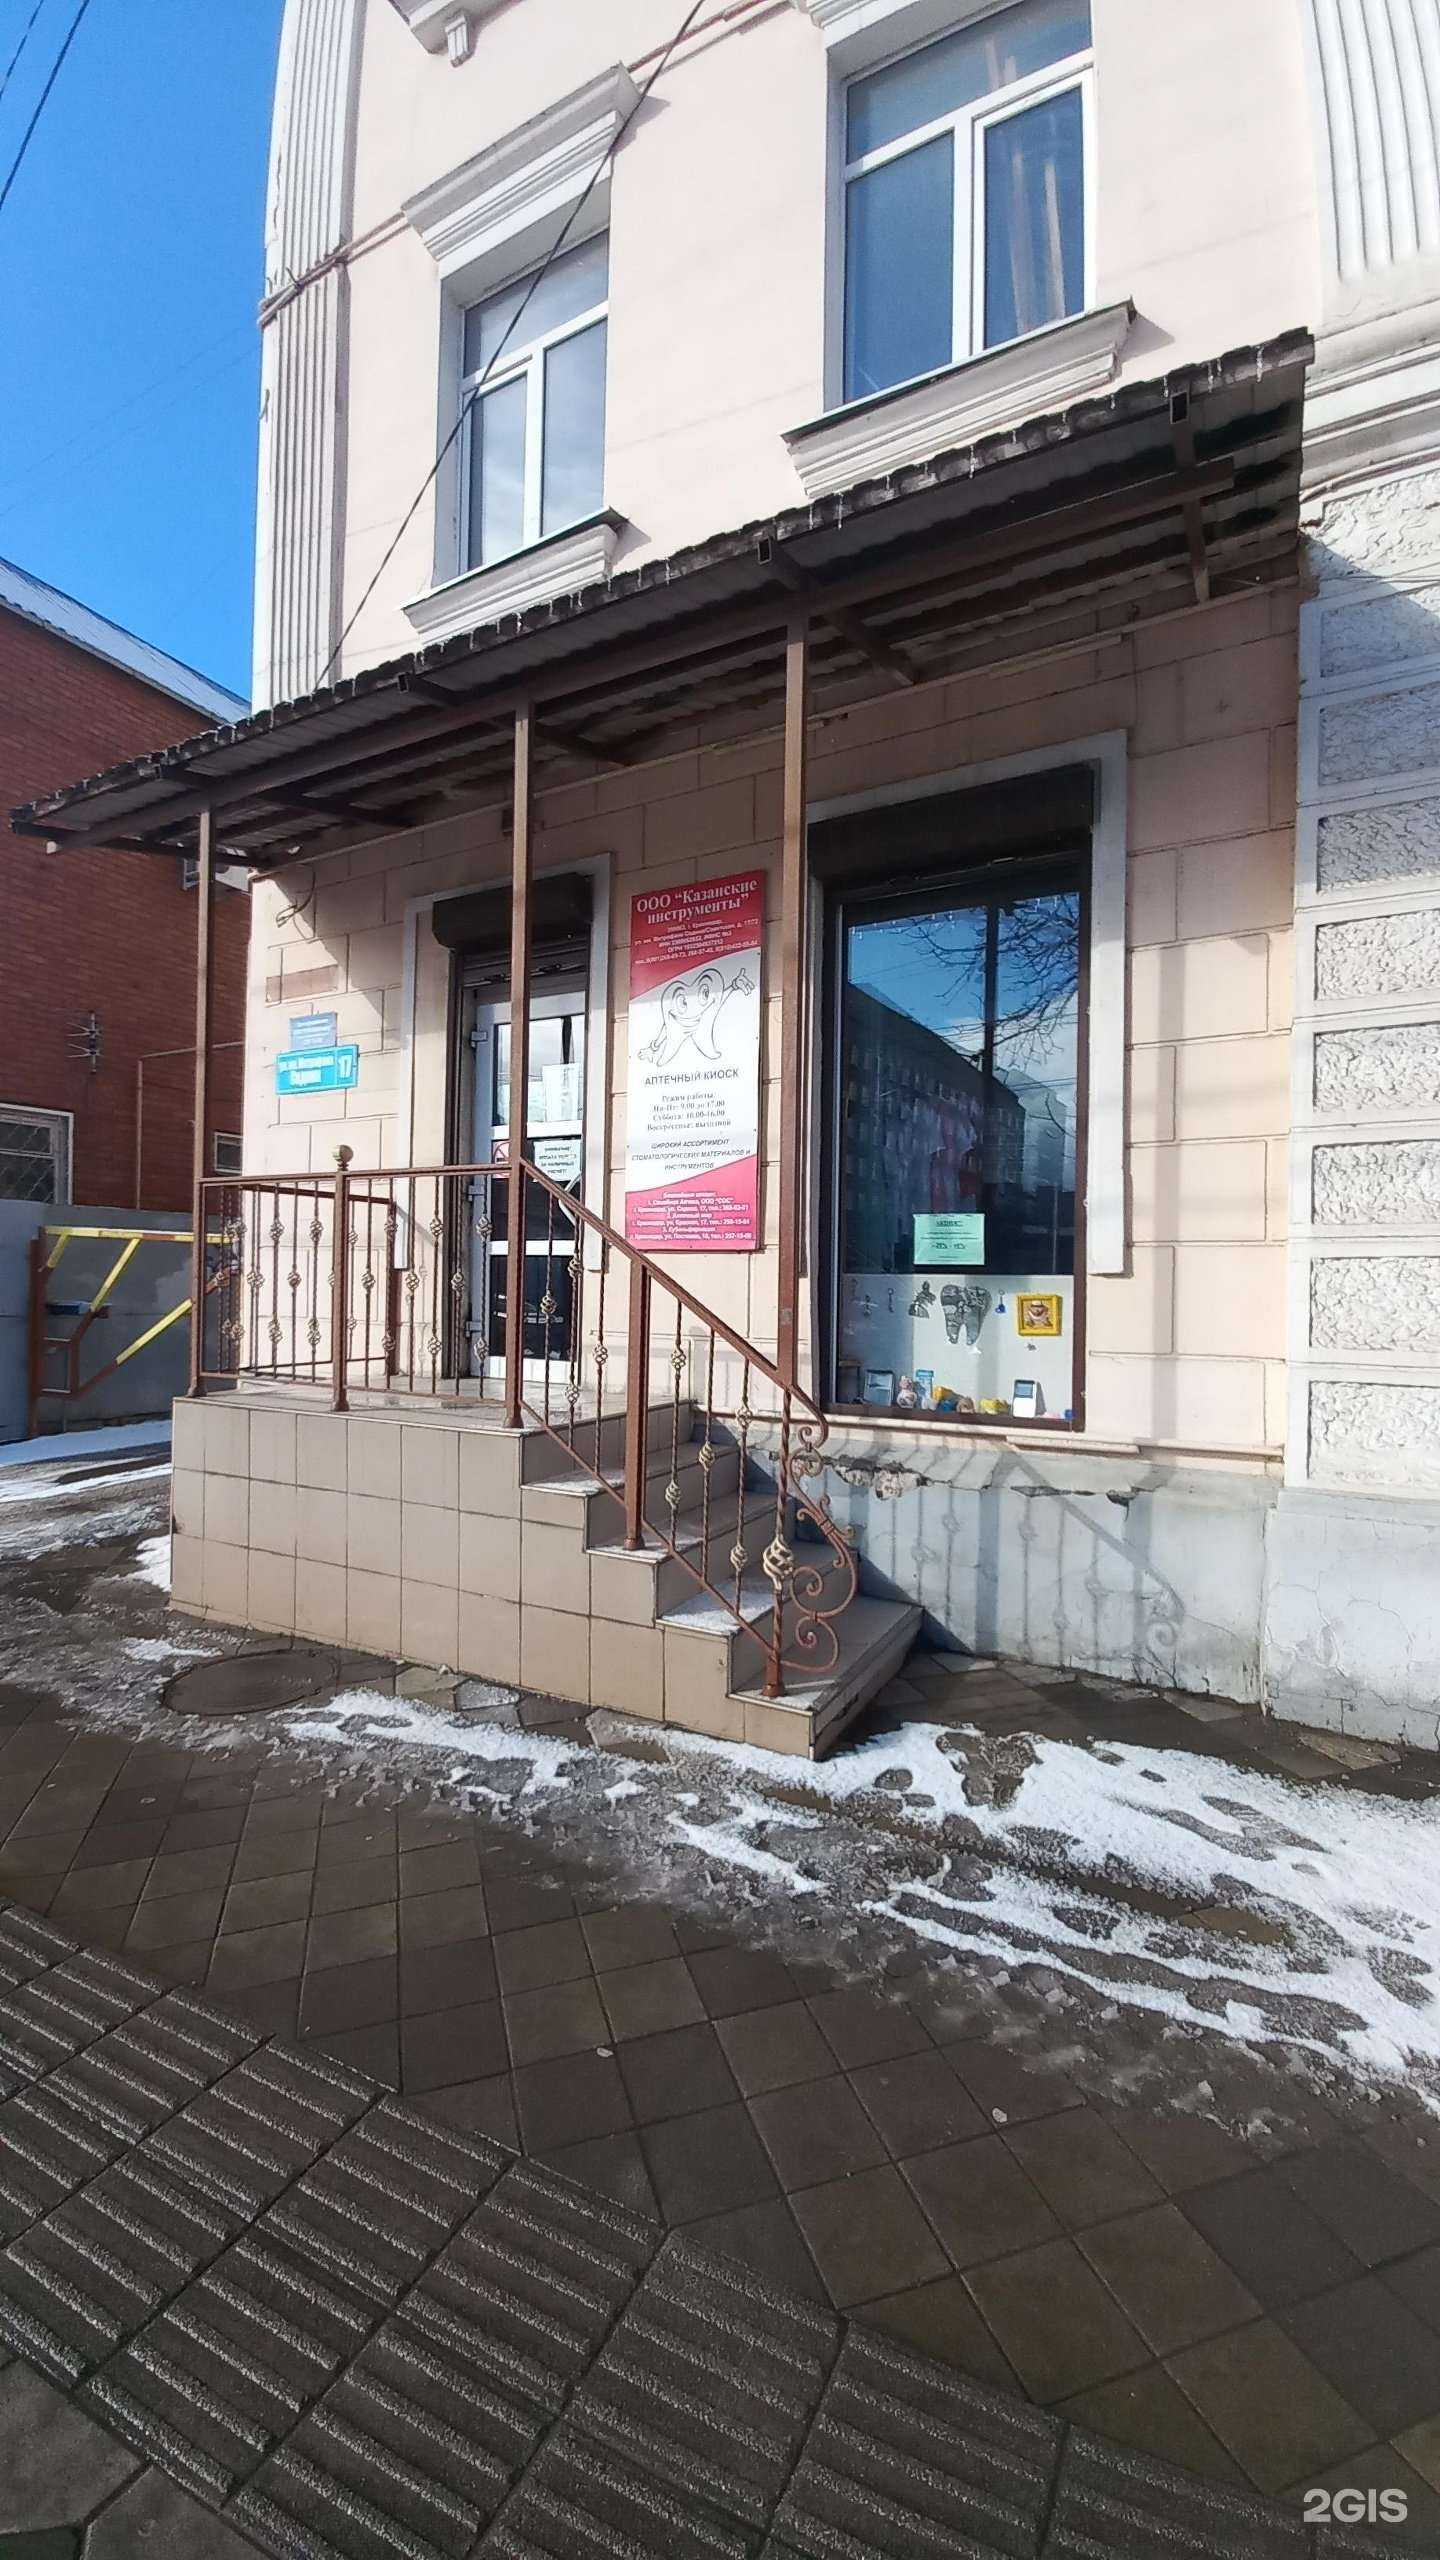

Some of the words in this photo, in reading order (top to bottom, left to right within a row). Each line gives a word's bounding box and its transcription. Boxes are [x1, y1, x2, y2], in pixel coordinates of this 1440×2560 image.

[636, 894, 671, 913] ООО
[645, 1071, 701, 1085] АПТЕЧНЫЙ
[703, 1068, 740, 1081] КИОСК
